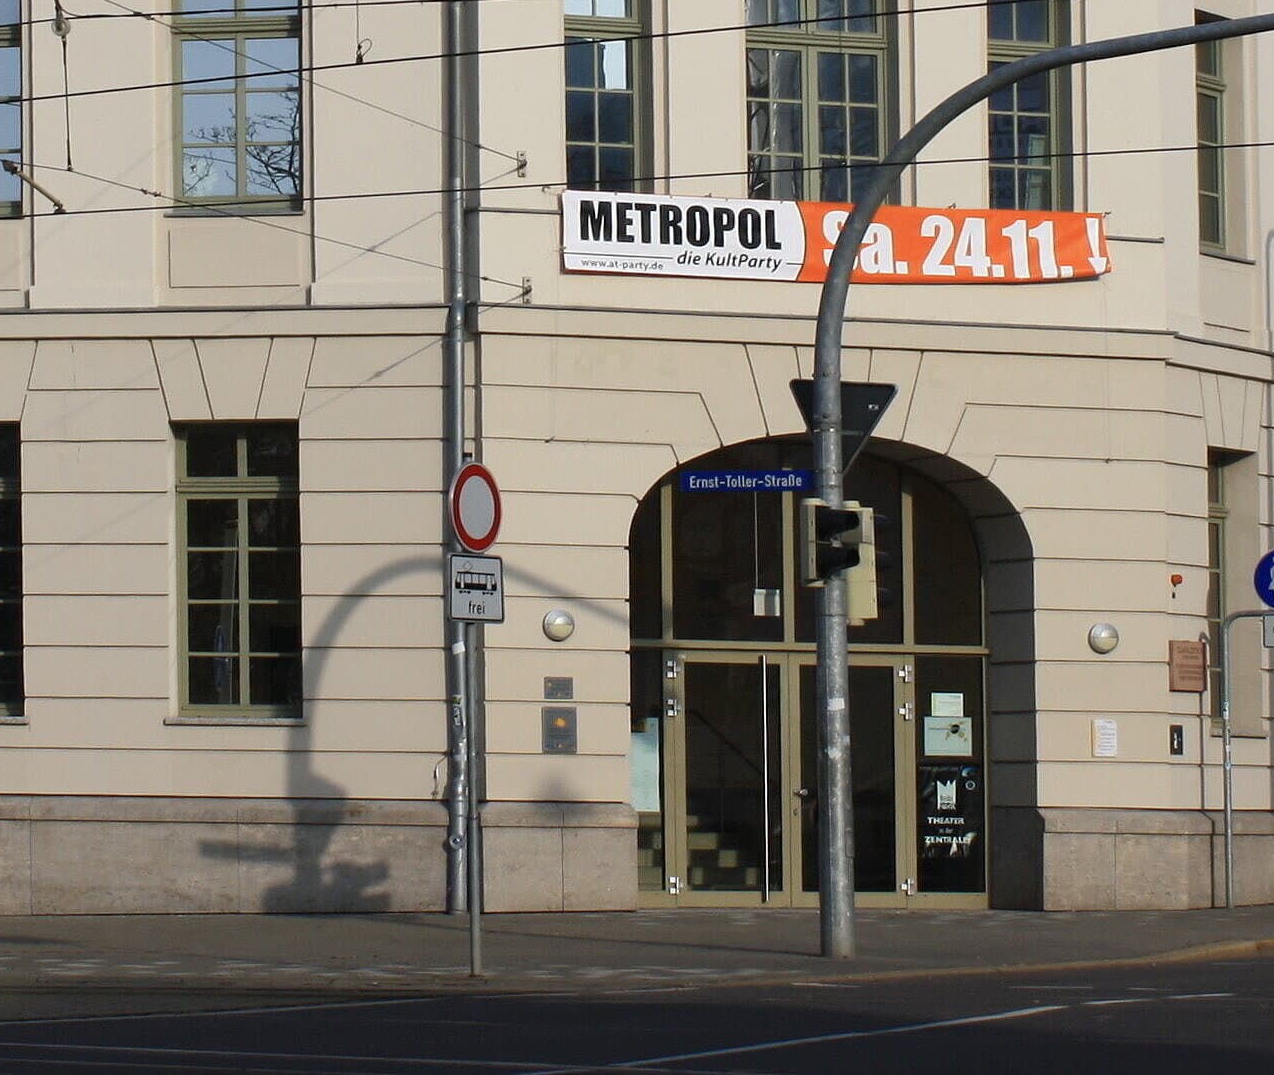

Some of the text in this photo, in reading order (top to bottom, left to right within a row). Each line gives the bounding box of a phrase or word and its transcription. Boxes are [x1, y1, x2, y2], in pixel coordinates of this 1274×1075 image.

[579, 199, 782, 250] METROPOL
[581, 257, 664, 270] www.at-party.de
[677, 250, 782, 273] die KultParty
[689, 474, 802, 488] Ernst-Toller-Straße
[468, 600, 486, 615] frei
[927, 816, 965, 825] THEATER
[924, 835, 971, 845] ZENTRALE
